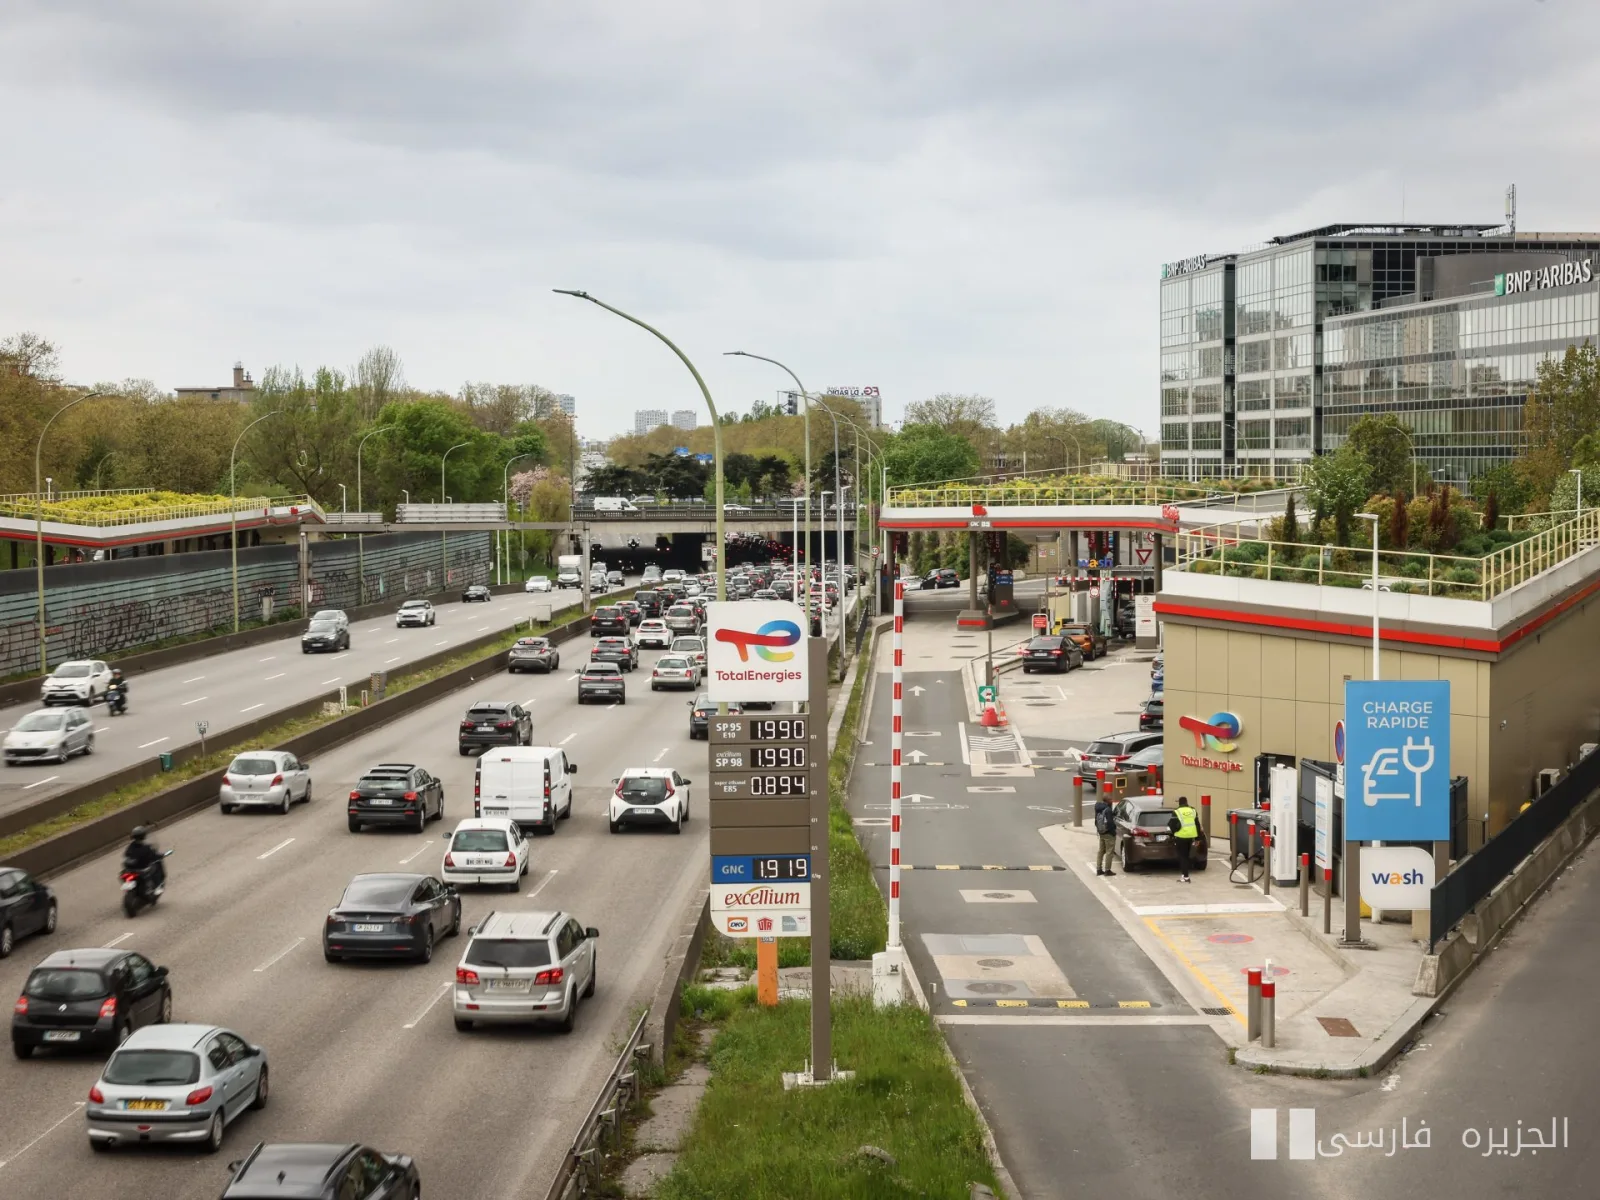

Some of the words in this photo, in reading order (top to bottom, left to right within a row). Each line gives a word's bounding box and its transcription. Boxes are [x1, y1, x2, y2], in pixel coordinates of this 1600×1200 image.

[1505, 270, 1532, 295] BNP
[1535, 259, 1592, 289] PARIBAS
[1078, 556, 1113, 568] wash
[715, 670, 802, 682] TotalEnergies
[1363, 701, 1433, 714] CHARGE
[716, 723, 729, 731] SP
[730, 723, 742, 731] 95
[757, 720, 805, 739] 1.990
[1367, 716, 1429, 728] RAPIDE
[715, 758, 729, 767] SP
[730, 757, 743, 767] 98
[757, 748, 805, 767] 1.990
[1180, 754, 1243, 773] TotalEnergies
[751, 776, 805, 795] 0.894
[722, 865, 744, 874] GNC
[760, 858, 807, 878] 1.919
[1371, 868, 1424, 885] wash
[724, 888, 800, 907] excellium
[757, 917, 773, 930] UTA
